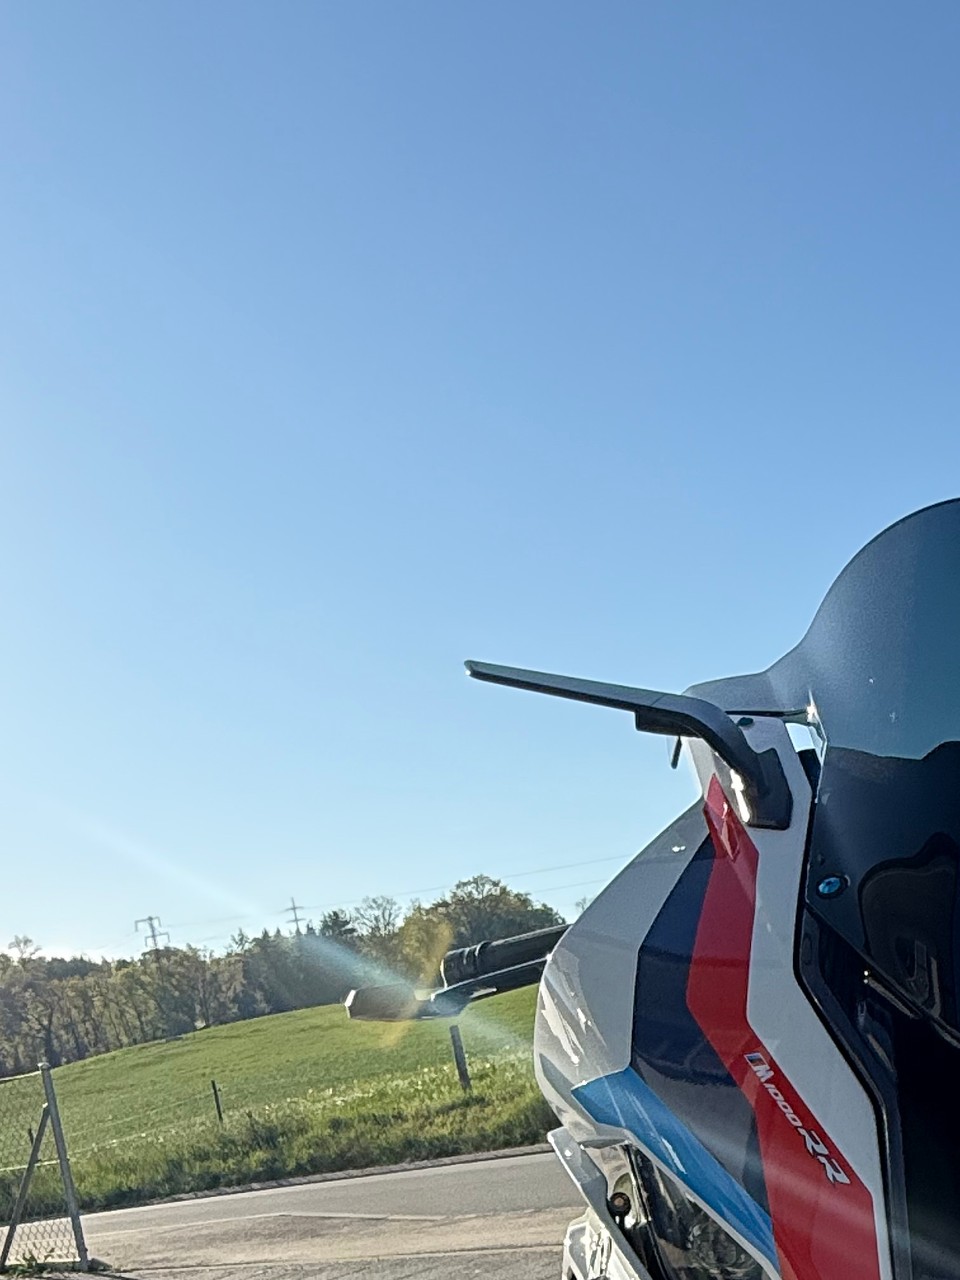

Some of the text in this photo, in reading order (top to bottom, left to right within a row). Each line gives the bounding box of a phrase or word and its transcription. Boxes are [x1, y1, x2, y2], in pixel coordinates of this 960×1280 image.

[753, 1064, 851, 1185] M 1000 RR
